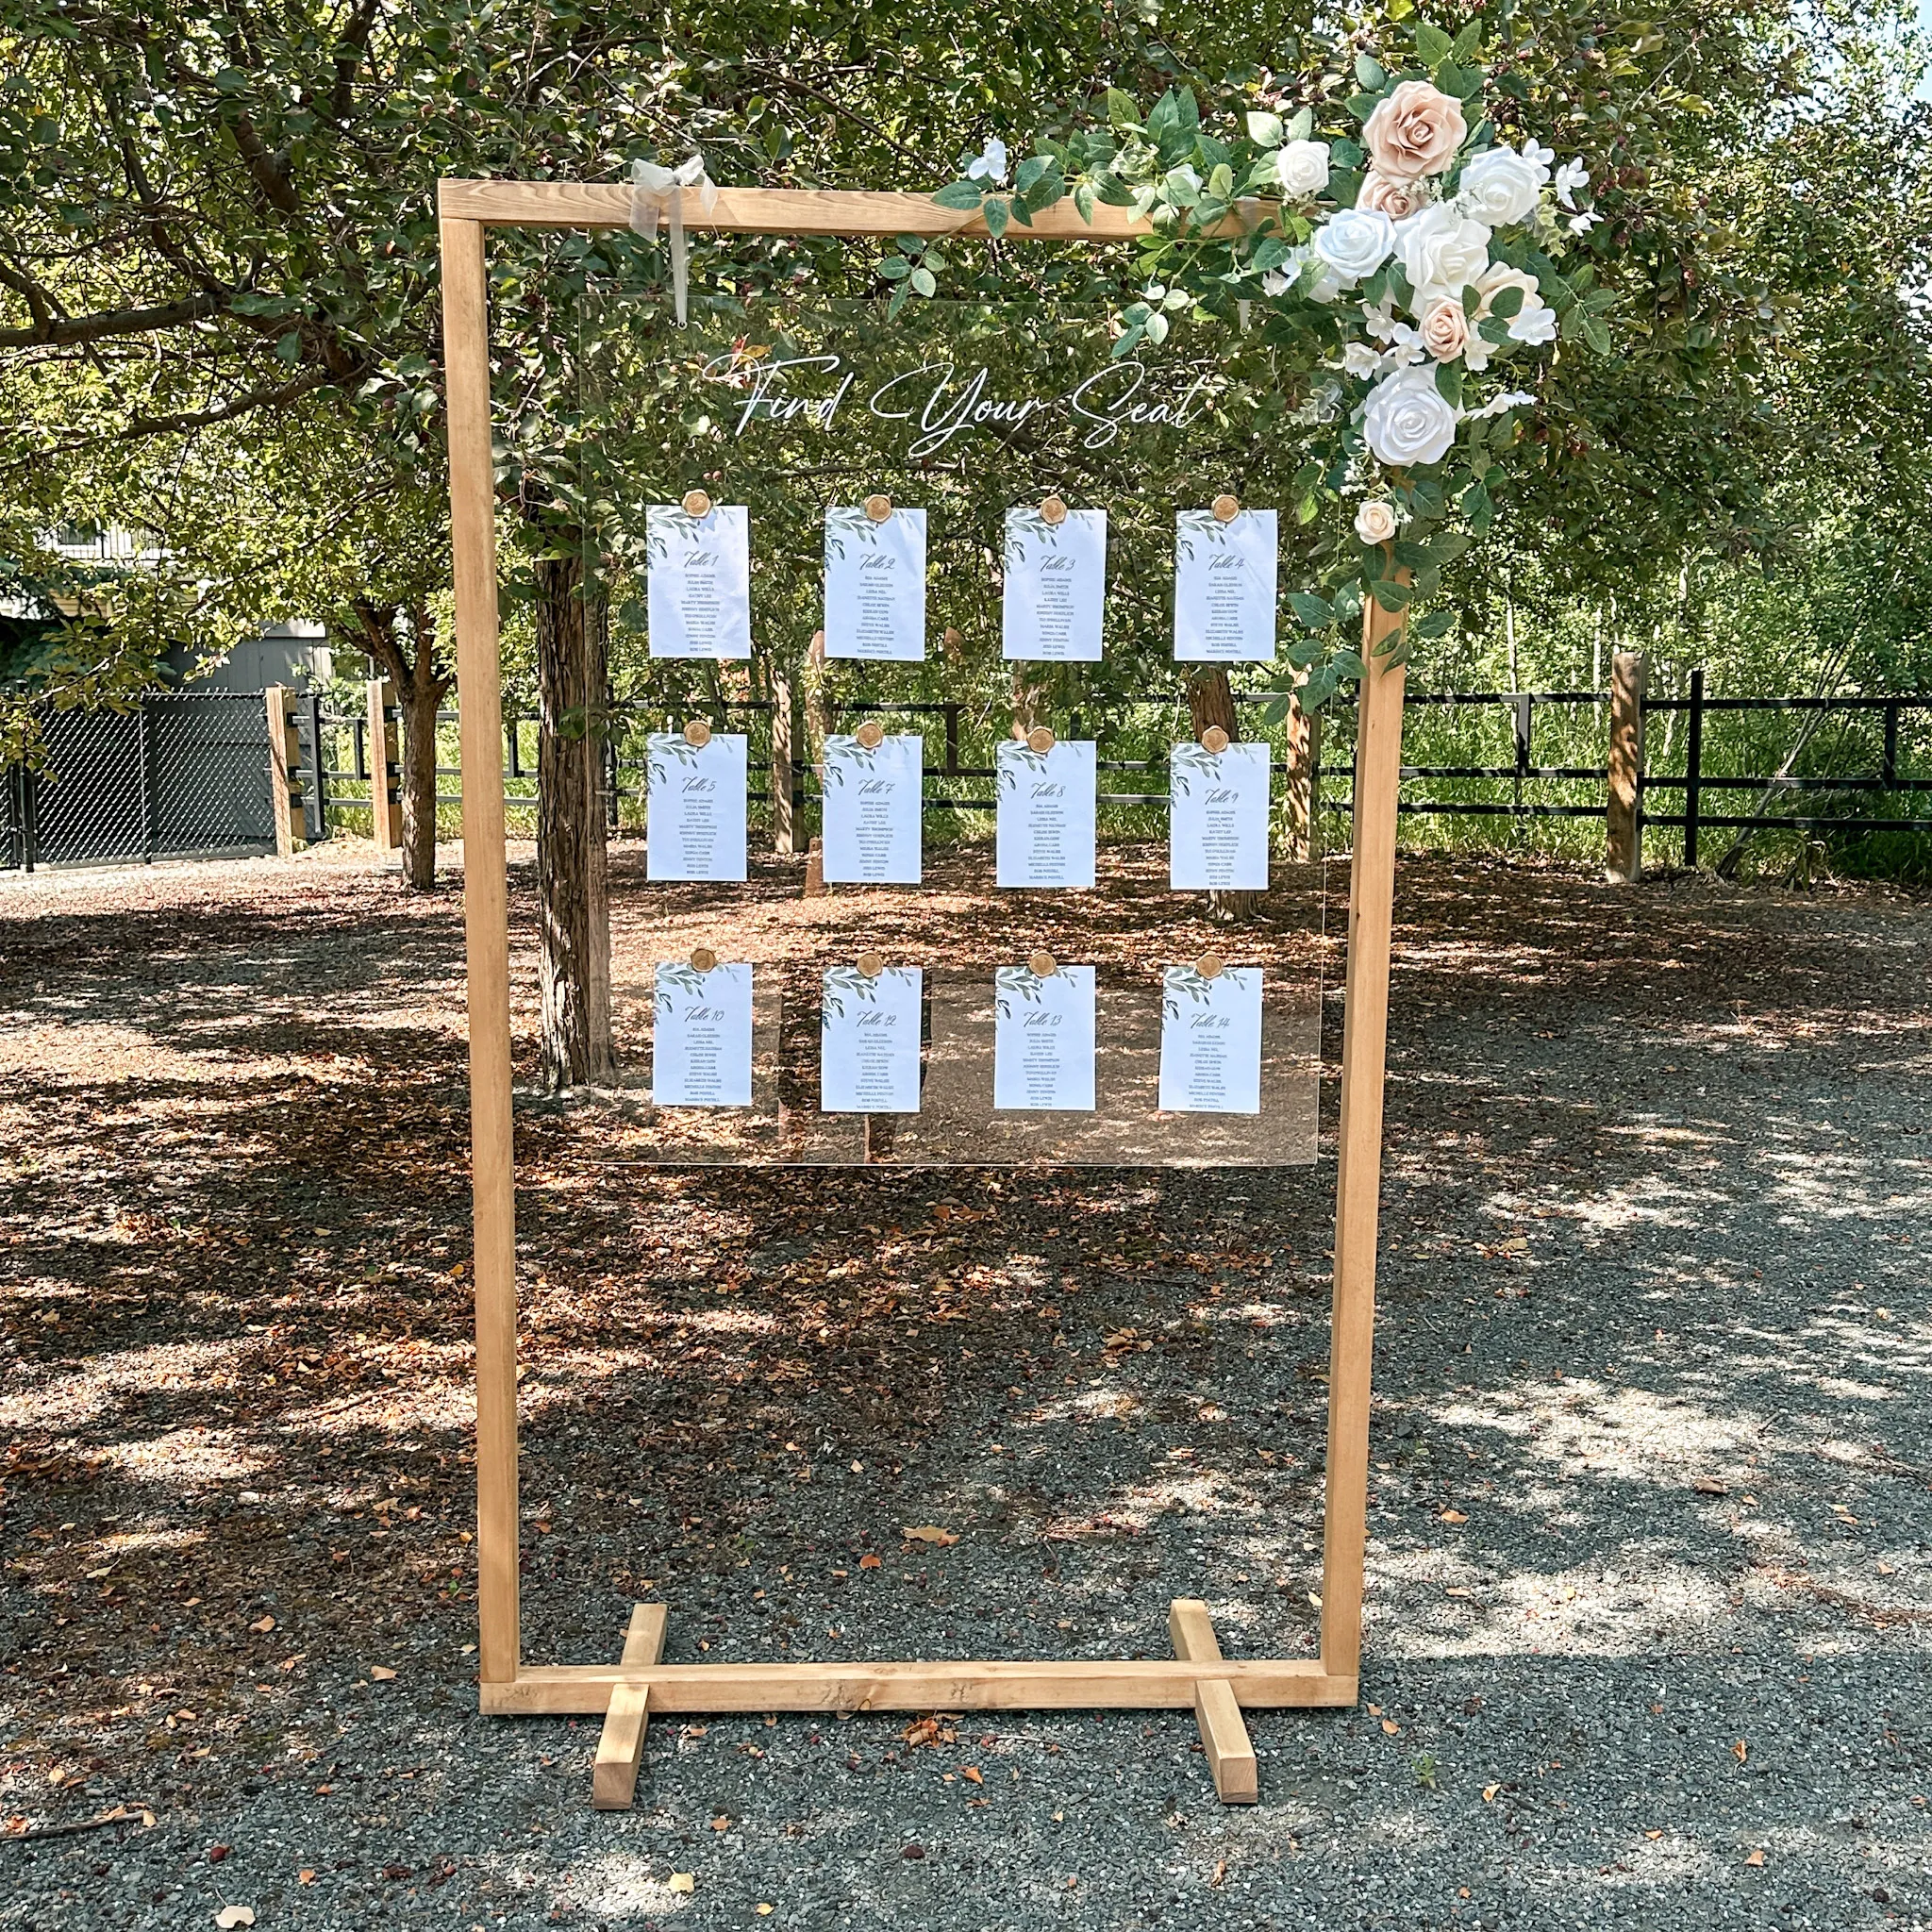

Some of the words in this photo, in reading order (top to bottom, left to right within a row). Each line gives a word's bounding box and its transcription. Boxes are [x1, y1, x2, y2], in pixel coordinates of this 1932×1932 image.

[702, 353, 853, 436] Find
[870, 362, 1041, 458] Your
[1070, 358, 1227, 448] Seat
[684, 551, 711, 568] Table
[711, 555, 719, 567] 1
[859, 553, 887, 571] Table
[884, 558, 895, 570] 2
[1041, 555, 1067, 572] Table
[1066, 558, 1075, 571] 3
[1208, 554, 1236, 571] Table
[1235, 558, 1244, 569] 4
[682, 776, 708, 793] Table
[708, 781, 717, 792] 5
[858, 779, 885, 795] Table
[886, 783, 895, 794] 7
[1031, 782, 1057, 799] Table
[1058, 786, 1066, 797] 8
[1205, 789, 1231, 805] Table
[1231, 792, 1239, 804] 9
[684, 1006, 711, 1023] Table
[711, 1010, 724, 1022] 10
[857, 1010, 883, 1027] Table
[884, 1014, 896, 1026] 12
[1024, 1011, 1050, 1027] Table
[1050, 1015, 1062, 1026] 13
[1191, 1012, 1217, 1029] Table
[1217, 1018, 1230, 1028] 14
